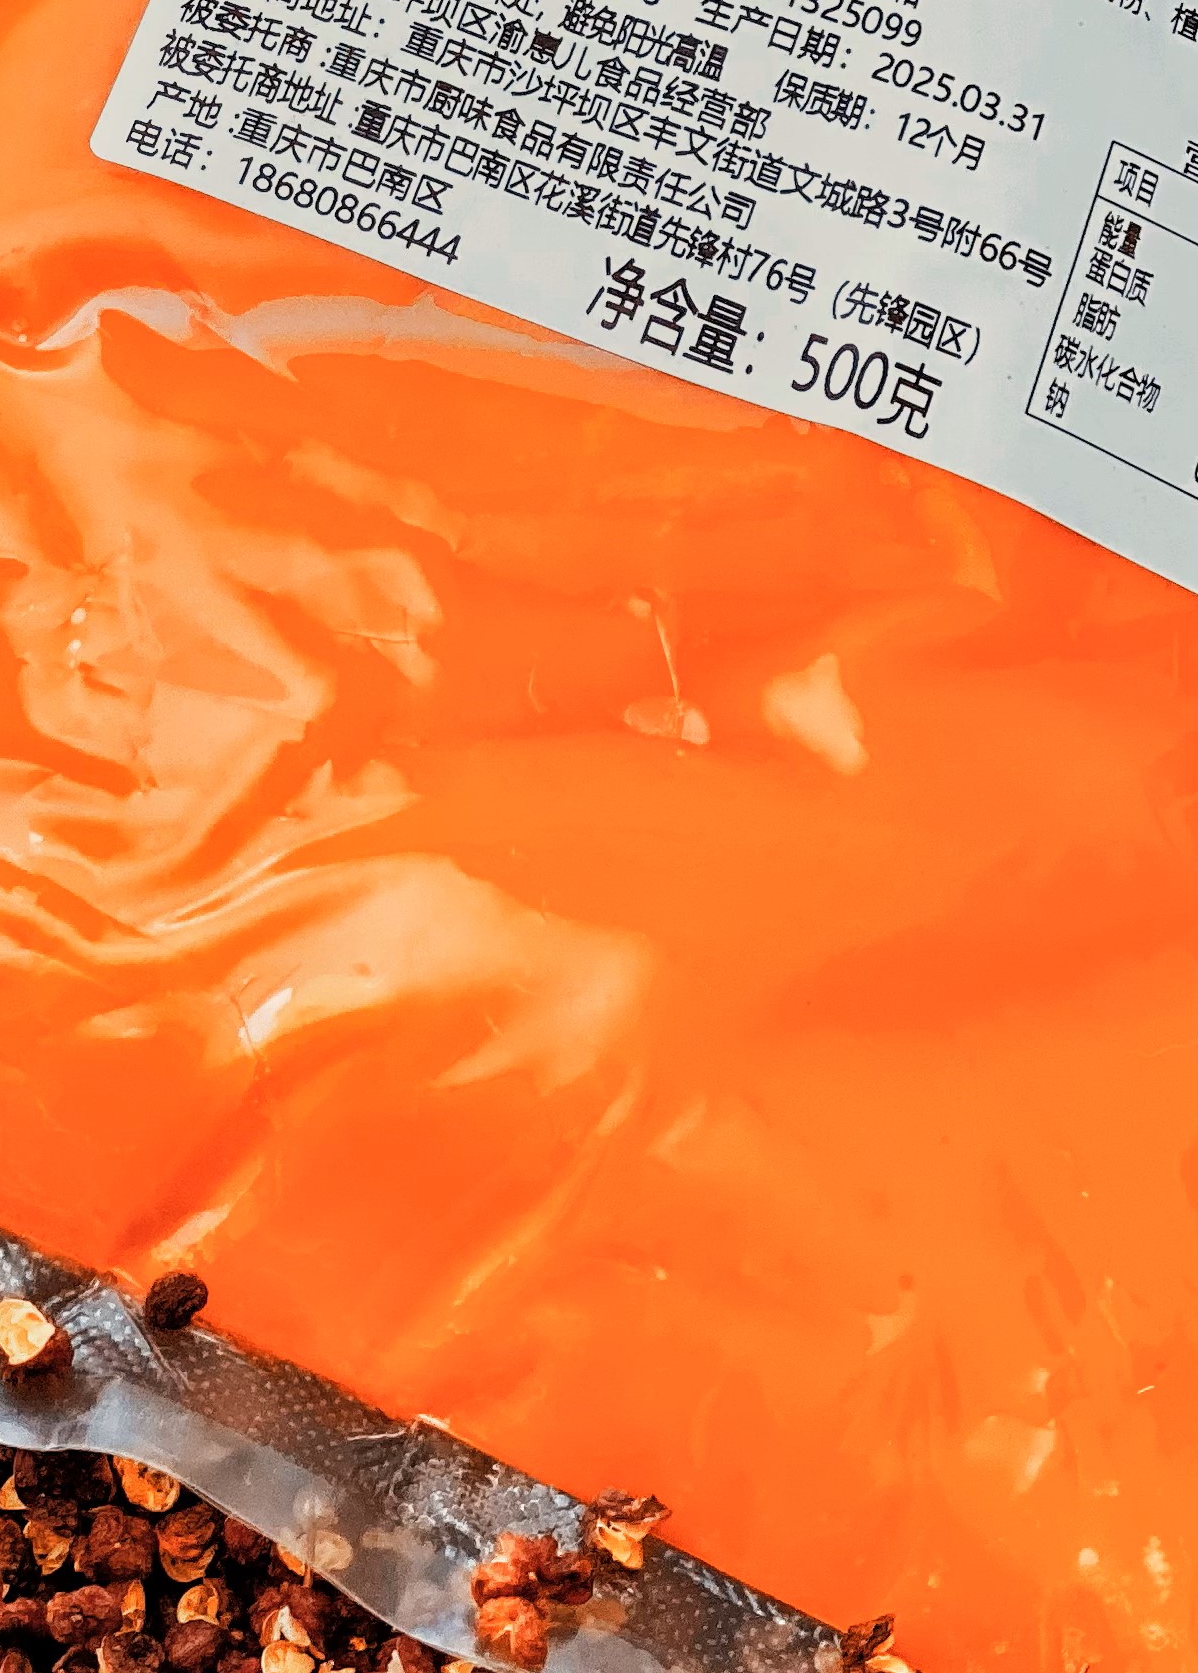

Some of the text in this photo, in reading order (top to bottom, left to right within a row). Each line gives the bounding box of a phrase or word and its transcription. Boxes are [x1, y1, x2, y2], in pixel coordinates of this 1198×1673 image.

[1113, 159, 1159, 207] 项目
[1098, 211, 1142, 259] 能量
[1085, 246, 1155, 307] 蛋白质
[1073, 292, 1121, 342] 脂肪
[1045, 377, 1070, 419] 钠
[1053, 335, 1162, 414] 碳水化合物
